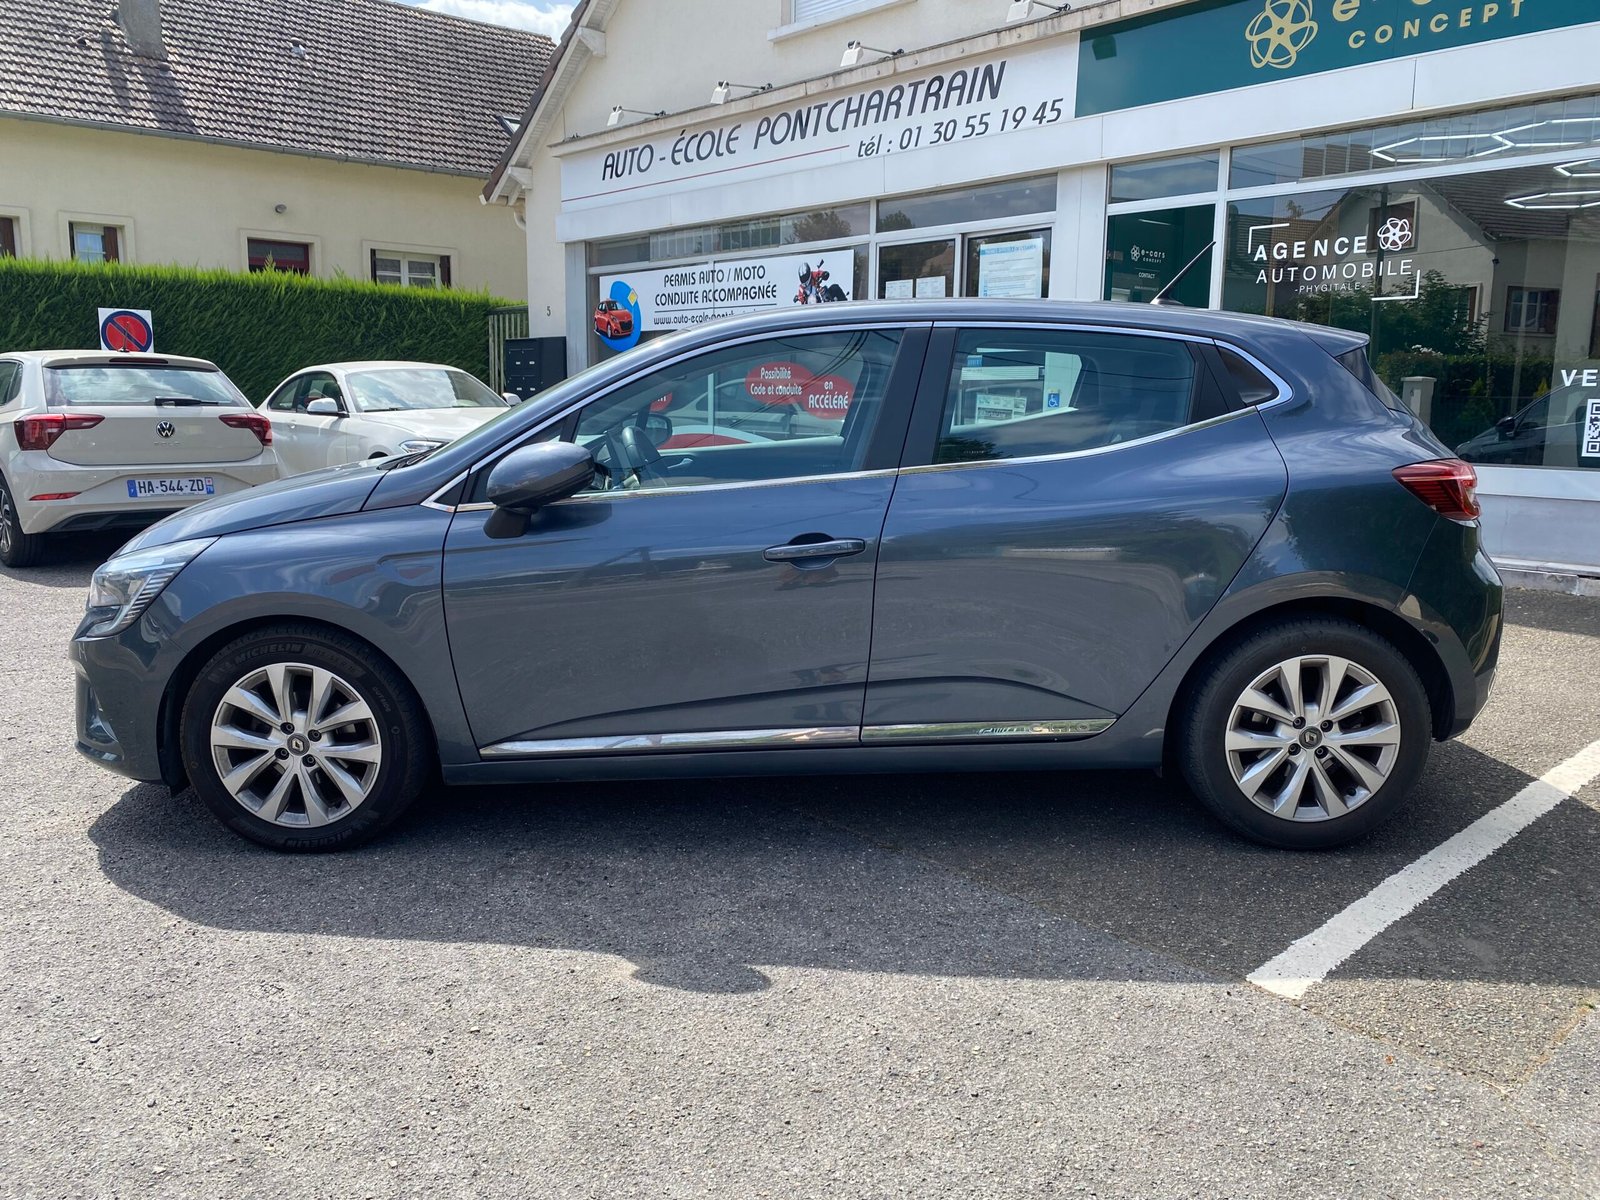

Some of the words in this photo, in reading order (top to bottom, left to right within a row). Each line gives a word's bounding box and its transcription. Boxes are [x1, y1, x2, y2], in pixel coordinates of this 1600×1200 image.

[1348, 0, 1525, 49] CONCEPT
[602, 143, 654, 181] AUTO
[671, 128, 742, 166] ÉCOLE
[753, 60, 1007, 150] PONTCHARTRAIN
[857, 133, 883, 158] tél
[899, 125, 922, 151] 01
[929, 118, 957, 145] 30
[962, 111, 991, 139] 55
[1000, 105, 1027, 132] 19
[1032, 98, 1064, 125] 45
[1140, 249, 1166, 259] e-cars
[1253, 235, 1367, 262] AGENCE
[663, 271, 696, 288] PERMIS
[699, 268, 725, 285] AUTO
[734, 264, 766, 282] MOTO
[1255, 259, 1413, 284] AUTOMOBILE
[654, 290, 699, 307] CONDUITE
[701, 280, 777, 304] ACCOMPAGNÉE
[546, 305, 552, 317] 5
[760, 366, 792, 380] Possibilité
[1560, 368, 1599, 387] VE
[750, 383, 766, 396] Code
[767, 384, 775, 396] et
[775, 382, 803, 396] conduite
[824, 381, 834, 390] en
[808, 391, 849, 410] ACCÉLÉRÉ
[137, 479, 204, 494] HA-544-ZD
[234, 642, 302, 664] MICHELIN
